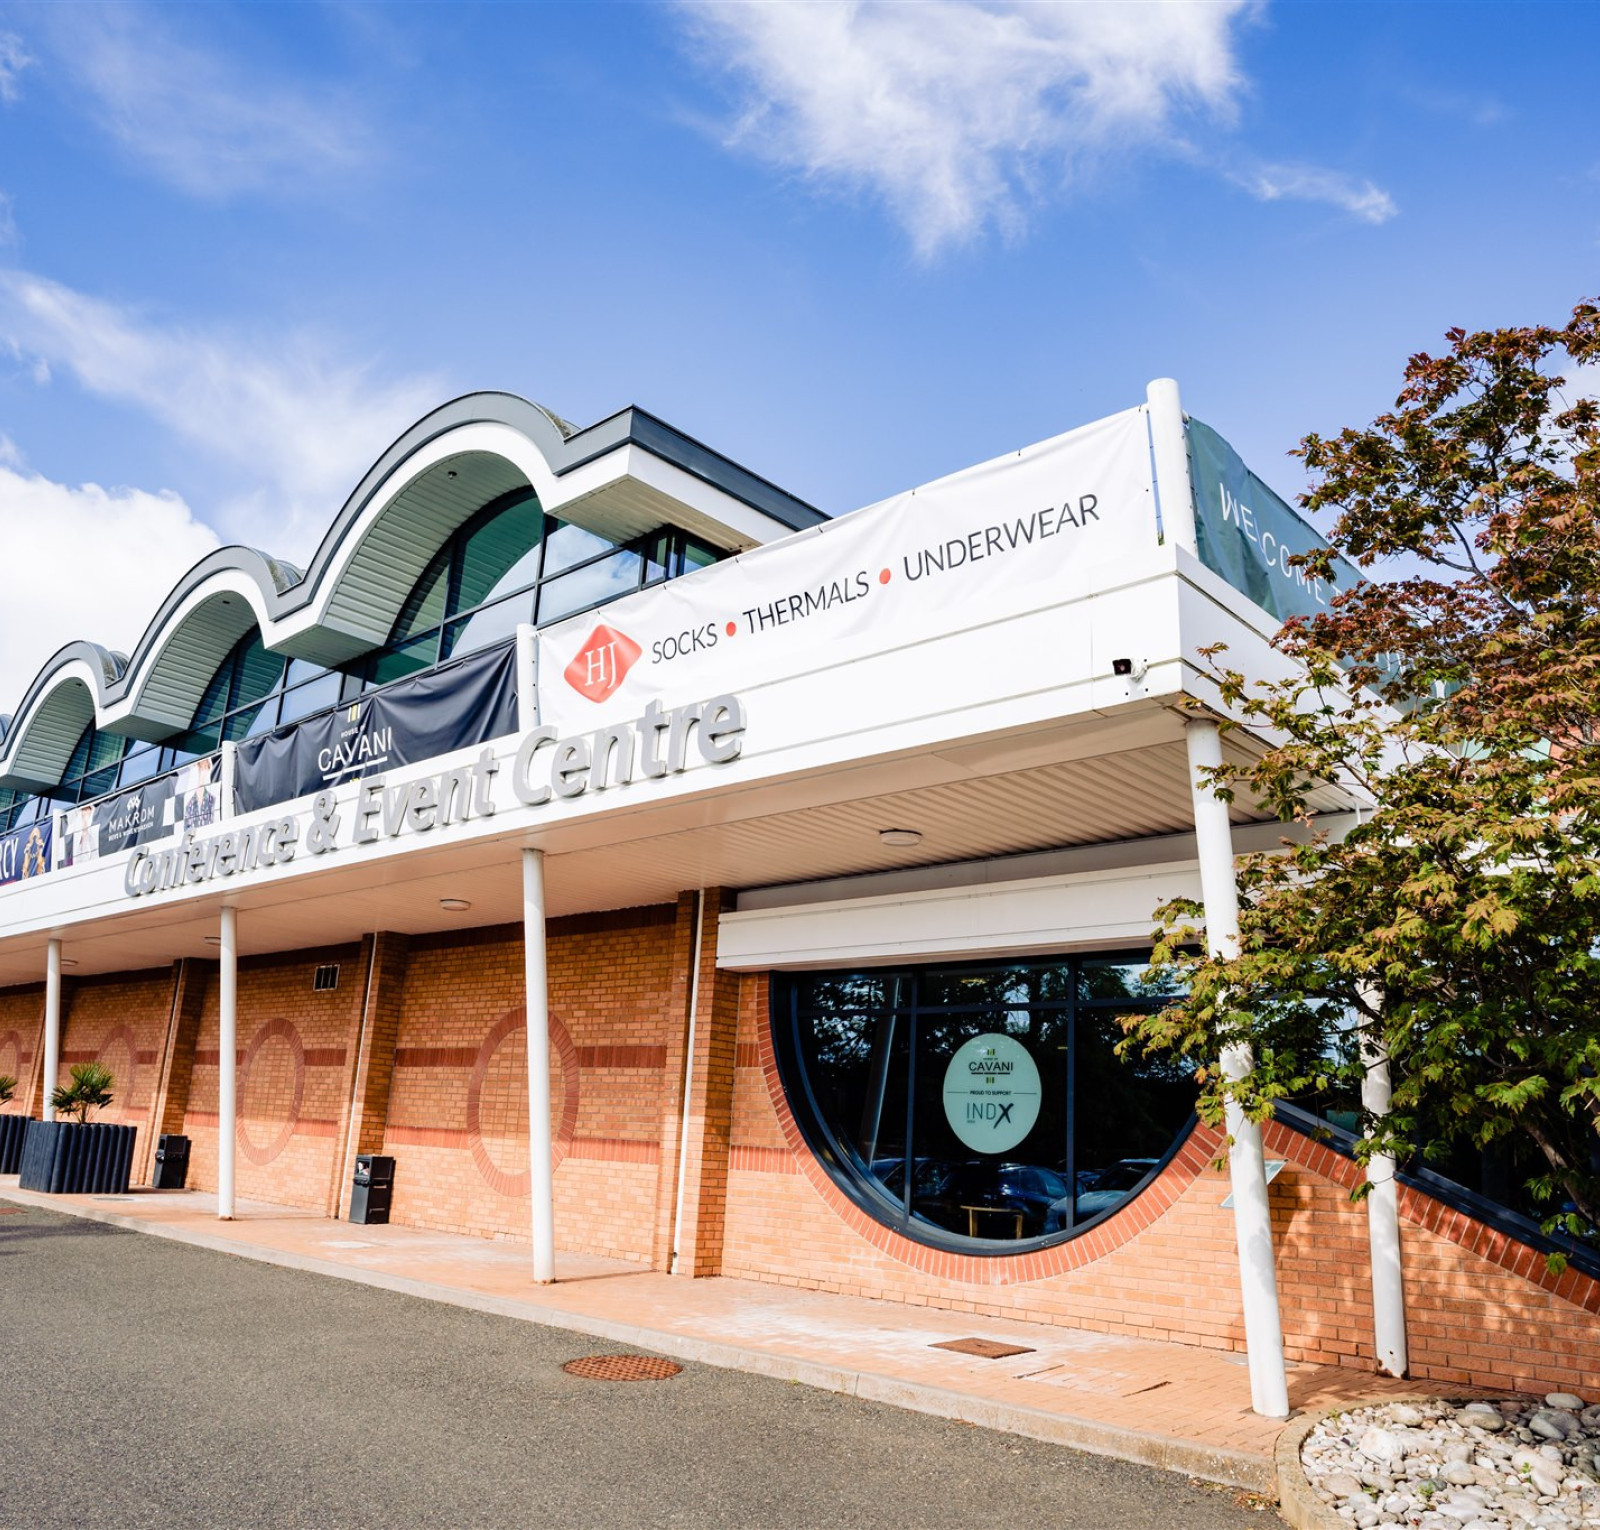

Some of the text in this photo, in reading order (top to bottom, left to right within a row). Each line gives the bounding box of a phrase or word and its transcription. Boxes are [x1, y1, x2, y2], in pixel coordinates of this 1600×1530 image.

[651, 493, 1101, 666] SOCKS THERMALS UNDERWEAR
[583, 641, 618, 689] HJ
[318, 726, 392, 772] CAVANI
[124, 694, 747, 897] Conference & Event Centre
[109, 805, 155, 834] MAKROM
[968, 1061, 1014, 1072] CAVANI
[966, 1102, 1014, 1129] INDX
